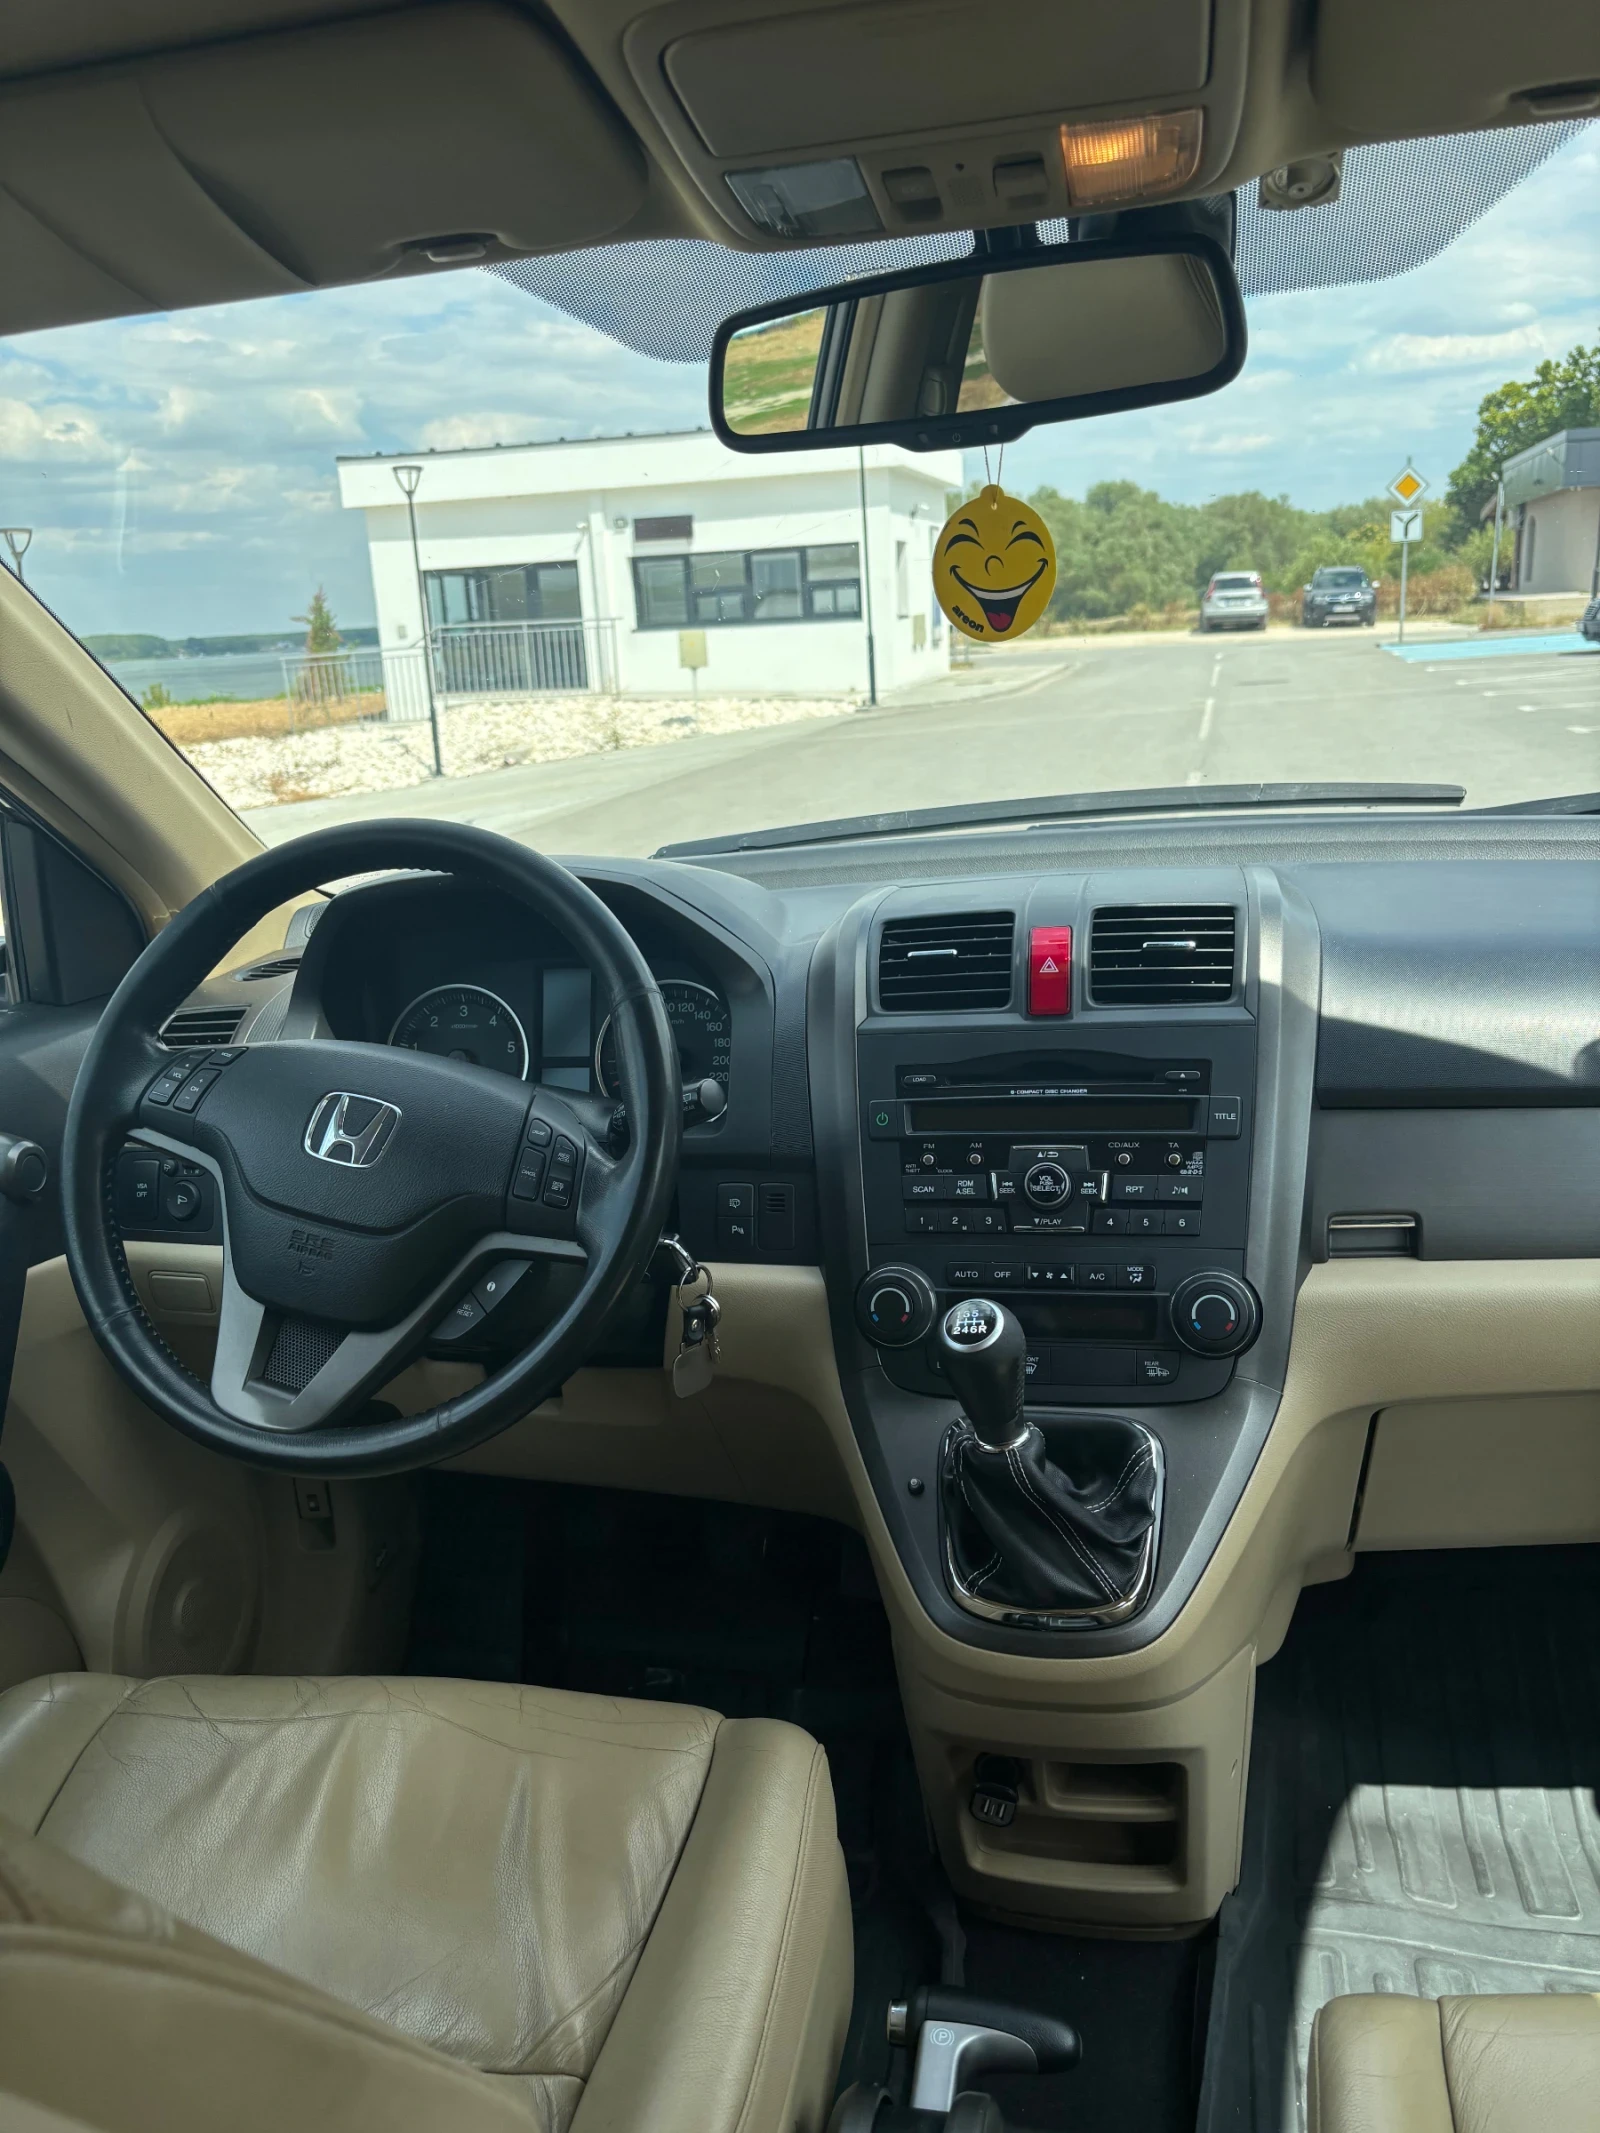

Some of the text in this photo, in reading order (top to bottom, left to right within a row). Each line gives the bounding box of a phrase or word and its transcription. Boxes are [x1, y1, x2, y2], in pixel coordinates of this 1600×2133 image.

[952, 605, 984, 633] areon
[460, 1005, 468, 1017] 3
[678, 1003, 695, 1012] 120
[694, 1011, 711, 1020] 140
[430, 1016, 439, 1027] 2
[489, 1015, 497, 1026] 4
[706, 1022, 723, 1031] 160
[507, 1041, 515, 1053] 5
[714, 1038, 731, 1047] 180
[1214, 1112, 1236, 1120] TITLE
[1108, 1141, 1140, 1149] CD/AUX
[955, 1187, 976, 1195] A.SEL
[1125, 1185, 1144, 1193] RPT
[919, 1217, 925, 1225] 1
[951, 1216, 959, 1225] 2
[985, 1216, 993, 1225] 3
[1106, 1218, 1114, 1226] 4
[1143, 1218, 1150, 1227] 5
[1178, 1218, 1186, 1227] 6
[954, 1270, 979, 1278] AUTO
[1089, 1273, 1105, 1281] A/C
[456, 1308, 474, 1318] RESET
